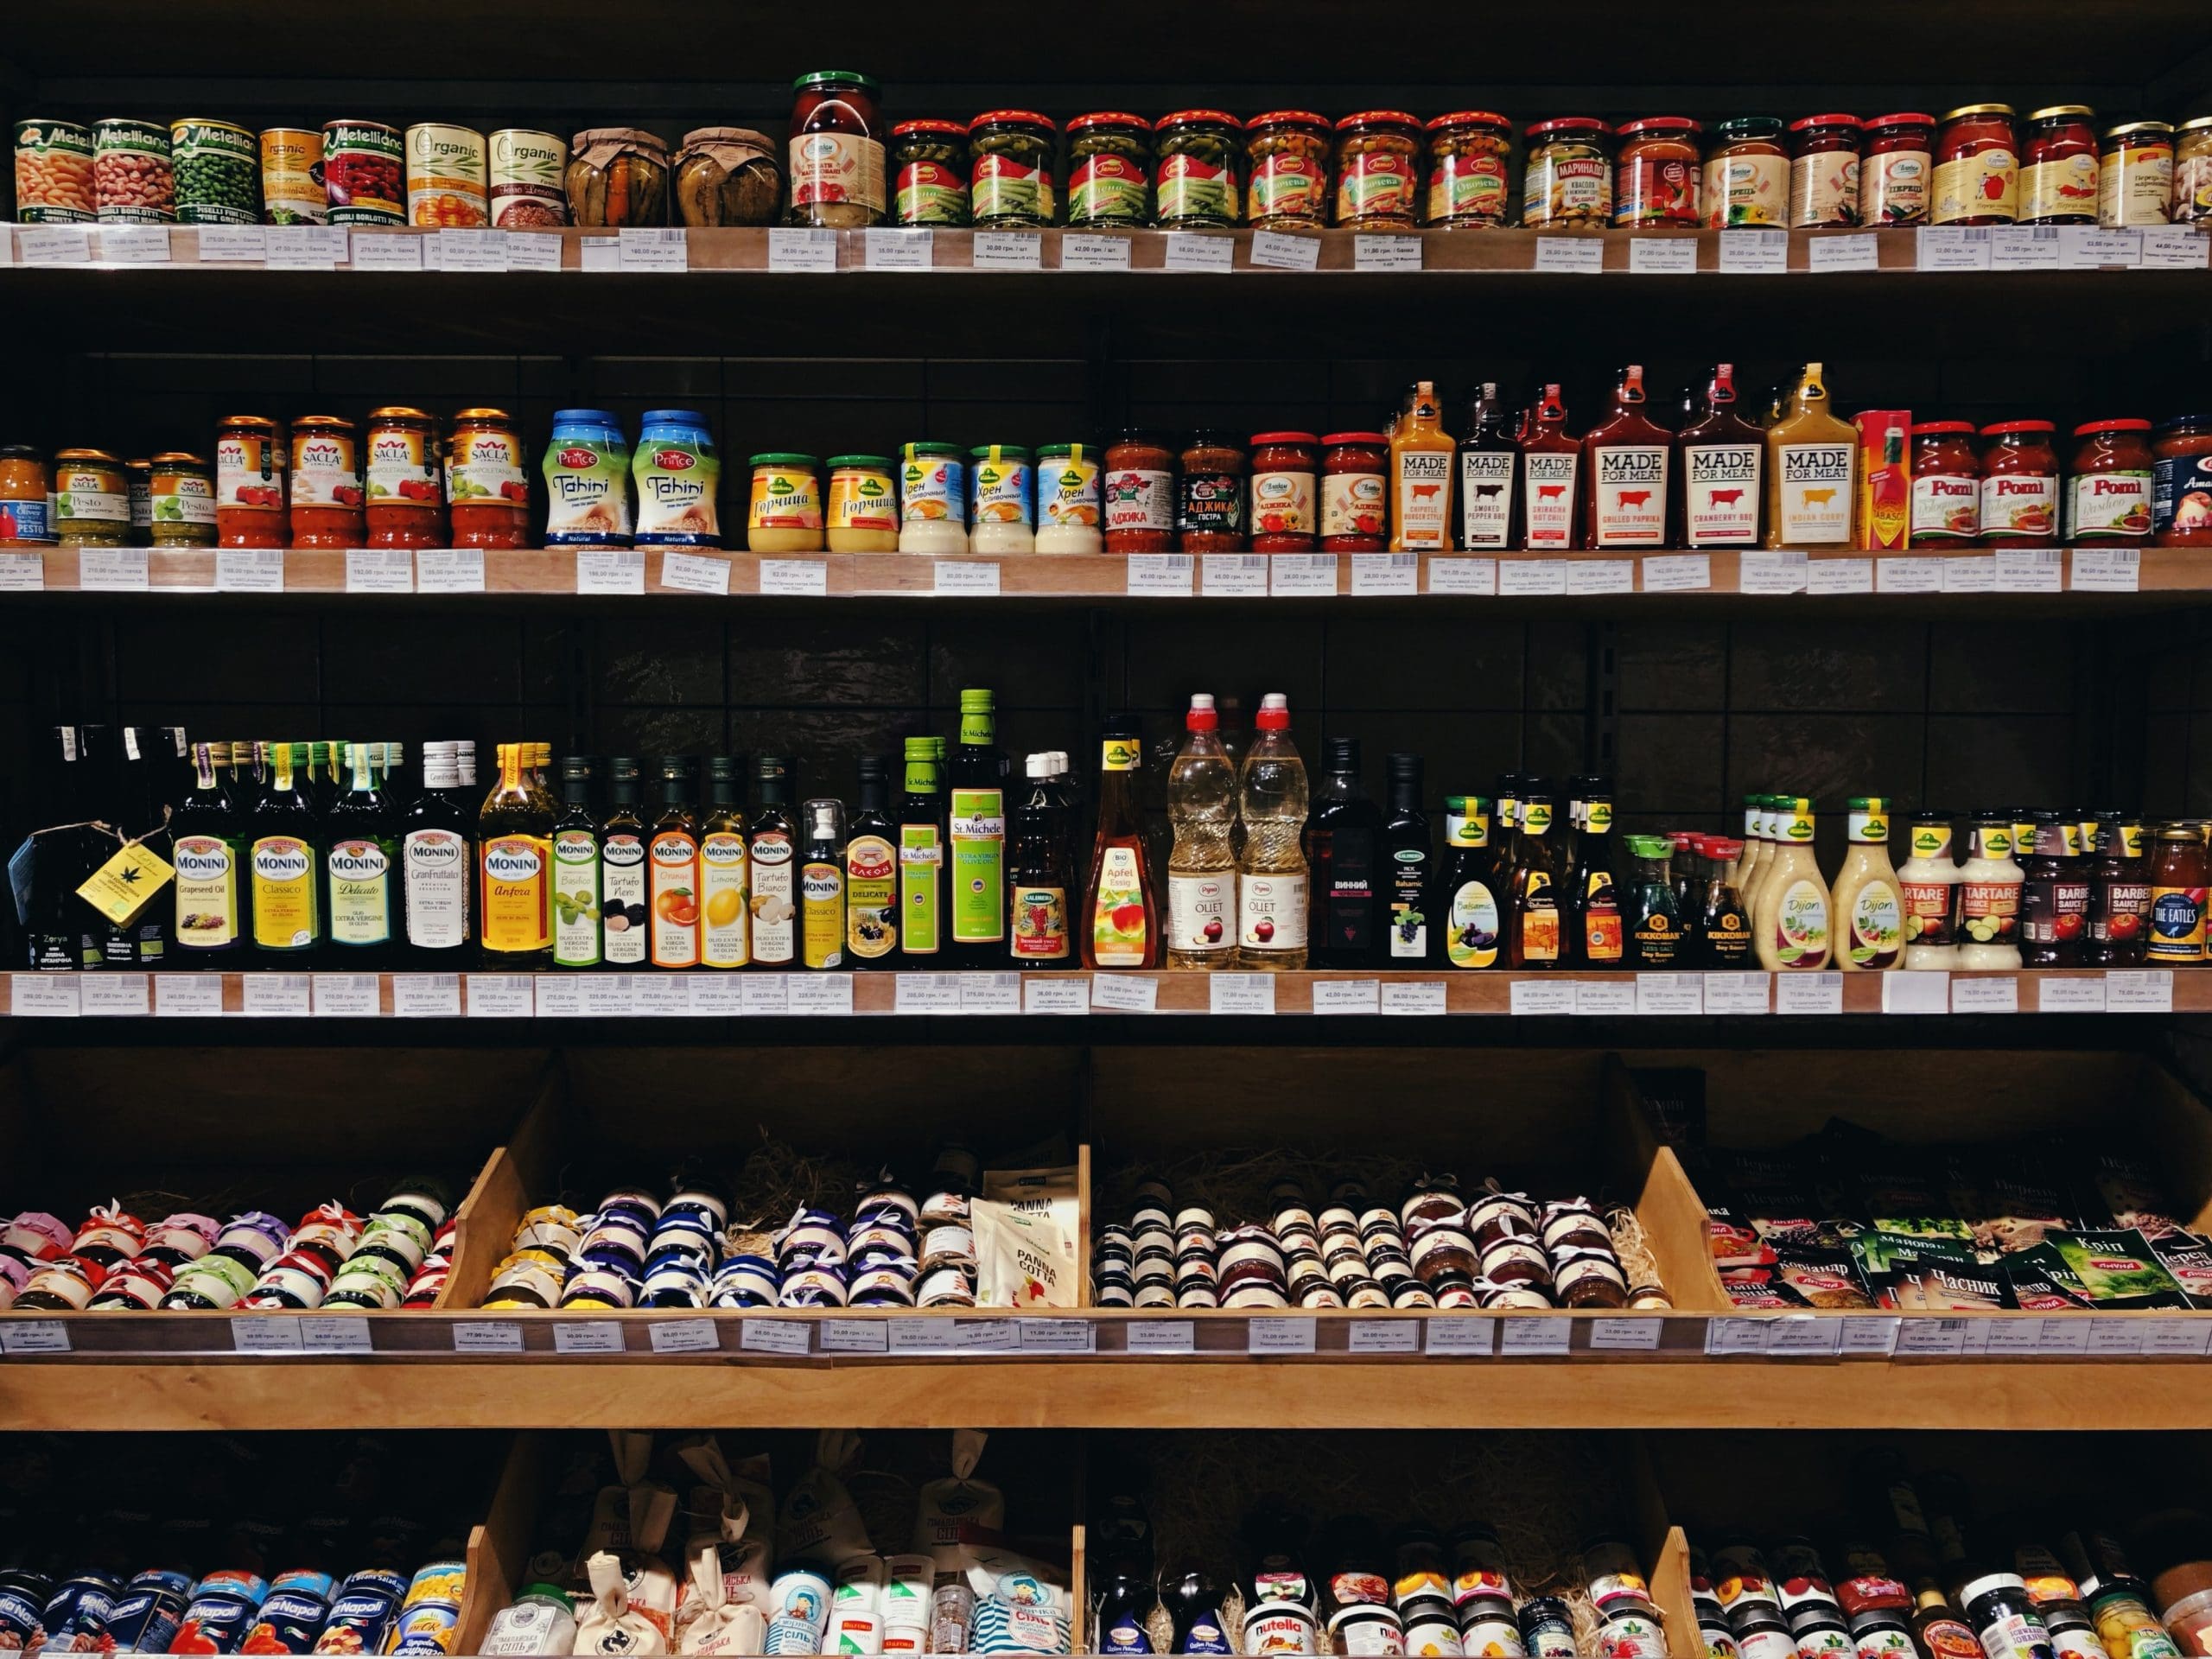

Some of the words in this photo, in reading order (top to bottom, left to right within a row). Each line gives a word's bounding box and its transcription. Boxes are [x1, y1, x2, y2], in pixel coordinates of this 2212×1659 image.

[328, 126, 403, 150] Metelliana
[416, 130, 478, 157] Organic
[497, 137, 557, 162] Organic
[1559, 162, 1604, 176] МАРИНАДО
[557, 451, 596, 467] Prince
[654, 453, 694, 467] Prince
[1403, 457, 1446, 469] MADE
[1466, 458, 1510, 469] MADE
[1529, 459, 1573, 470] MADE
[1602, 454, 1662, 470] MADE
[1693, 453, 1754, 469] MADE
[1785, 451, 1847, 468] MADE
[1601, 470, 1628, 481] FOR
[1630, 469, 1662, 480] MEAT
[1692, 469, 1717, 480] FOR
[1719, 468, 1755, 480] MEAT
[1785, 468, 1809, 480] FOR
[1812, 467, 1848, 479] MEAT
[552, 475, 608, 499] Tahini
[646, 476, 704, 500] Tahini
[904, 482, 925, 497] Хрен
[977, 485, 1002, 498] Хрен
[1998, 480, 2044, 495] Pomì
[909, 489, 946, 500] сливочный
[984, 492, 1021, 503] сливочный
[1057, 487, 1084, 501] Хрен
[73, 497, 101, 506] Pesto
[181, 500, 208, 511] Pesto
[754, 493, 809, 518] Горчица
[1187, 501, 1233, 514] АДЖИКА
[1111, 512, 1147, 523] АДЖИКА
[1198, 512, 1222, 522] ГОСТРА
[1738, 513, 1753, 522] BBQ
[413, 847, 454, 857] MONINI
[557, 845, 593, 855] MONINI
[606, 846, 642, 855] MONINI
[654, 848, 692, 856] MONINI
[706, 848, 742, 856] MONINI
[753, 846, 789, 855] MONINI
[176, 856, 226, 869] MONINI
[257, 857, 305, 869] MONINI
[331, 856, 384, 870] MONINI
[487, 857, 537, 870] MONINI
[660, 871, 690, 880] Orange
[711, 874, 739, 883] Limone
[755, 873, 789, 882] Tartufo
[1107, 868, 1134, 878] Apfel
[561, 875, 590, 886] Basilico
[608, 877, 639, 887] Tartufo
[802, 881, 839, 892] MONINI
[1109, 878, 1131, 887] Essig
[1334, 880, 1368, 890] ВИННИЙ
[180, 885, 213, 895] Grapeseed
[215, 885, 225, 894] Oil
[263, 885, 301, 894] Classico
[339, 885, 379, 896] Delicato
[494, 886, 531, 897] Anfora
[614, 887, 634, 897] Nero
[757, 883, 787, 893] Bianco
[1965, 887, 2019, 899] TARTARE
[805, 906, 836, 916] Classico
[1195, 902, 1224, 913] ОЦЕТ
[1249, 901, 1276, 913] ОЦЕТ
[1788, 899, 1820, 912] Dijon
[1860, 899, 1892, 912] Dijon
[2155, 908, 2166, 921] THE
[2169, 909, 2196, 924] EATLES
[2075, 1236, 2125, 1252] Кріп
[1017, 1249, 1057, 1279] PANNA
[1778, 1261, 1848, 1275] Коріандр
[1020, 1262, 1055, 1287] COTTA
[1931, 1268, 2001, 1296] Часник
[195, 1605, 242, 1618] Napoli
[283, 1599, 321, 1618] Napoli
[341, 1603, 383, 1613] Napoli
[1256, 1619, 1301, 1636] nutella
[785, 1631, 810, 1642] СІЛЬ
